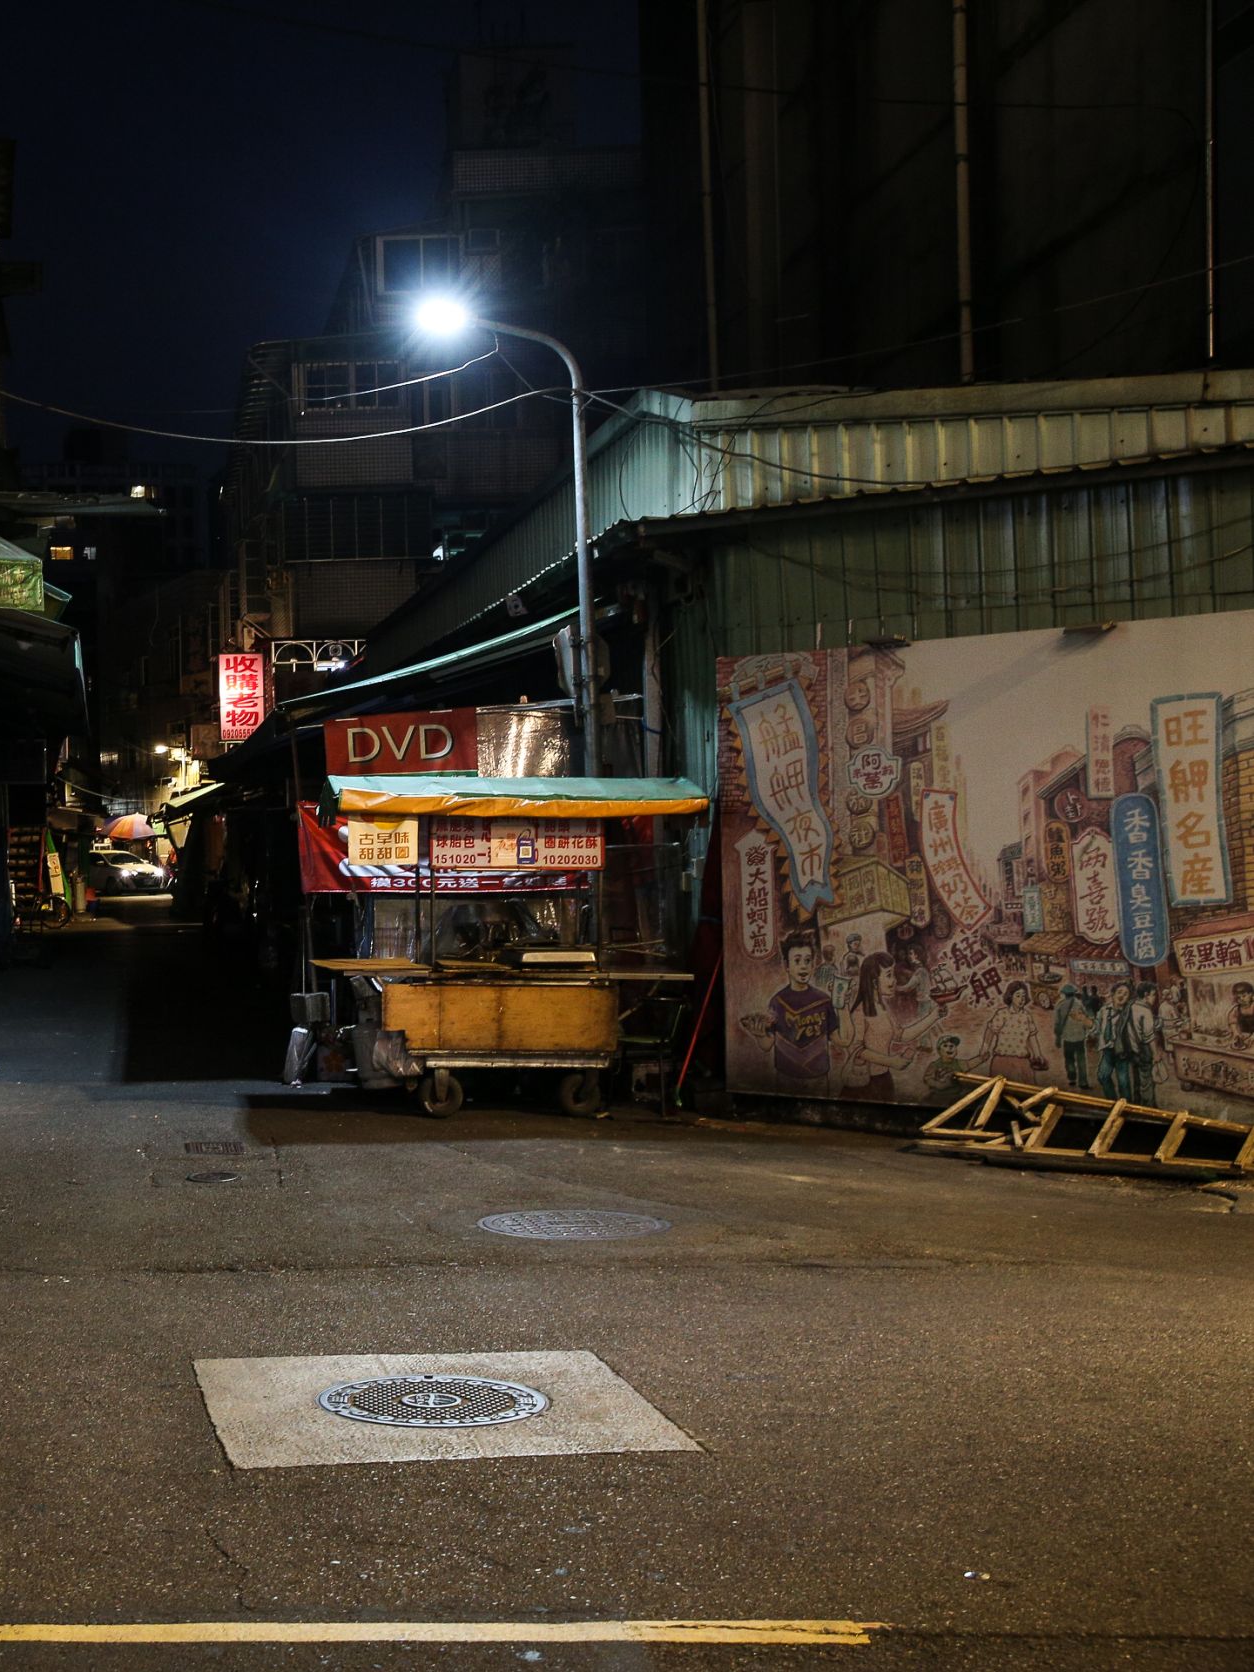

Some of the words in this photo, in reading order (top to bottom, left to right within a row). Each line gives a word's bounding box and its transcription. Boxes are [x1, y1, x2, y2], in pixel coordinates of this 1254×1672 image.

[225, 656, 258, 727] 收購老物
[222, 728, 254, 739] 0920555
[347, 724, 453, 763] DVD
[758, 703, 823, 877] 艋舺夜市
[359, 832, 410, 845] 古早味
[1123, 808, 1156, 960] 香香臭豆腐
[1196, 938, 1243, 970] 黑輪
